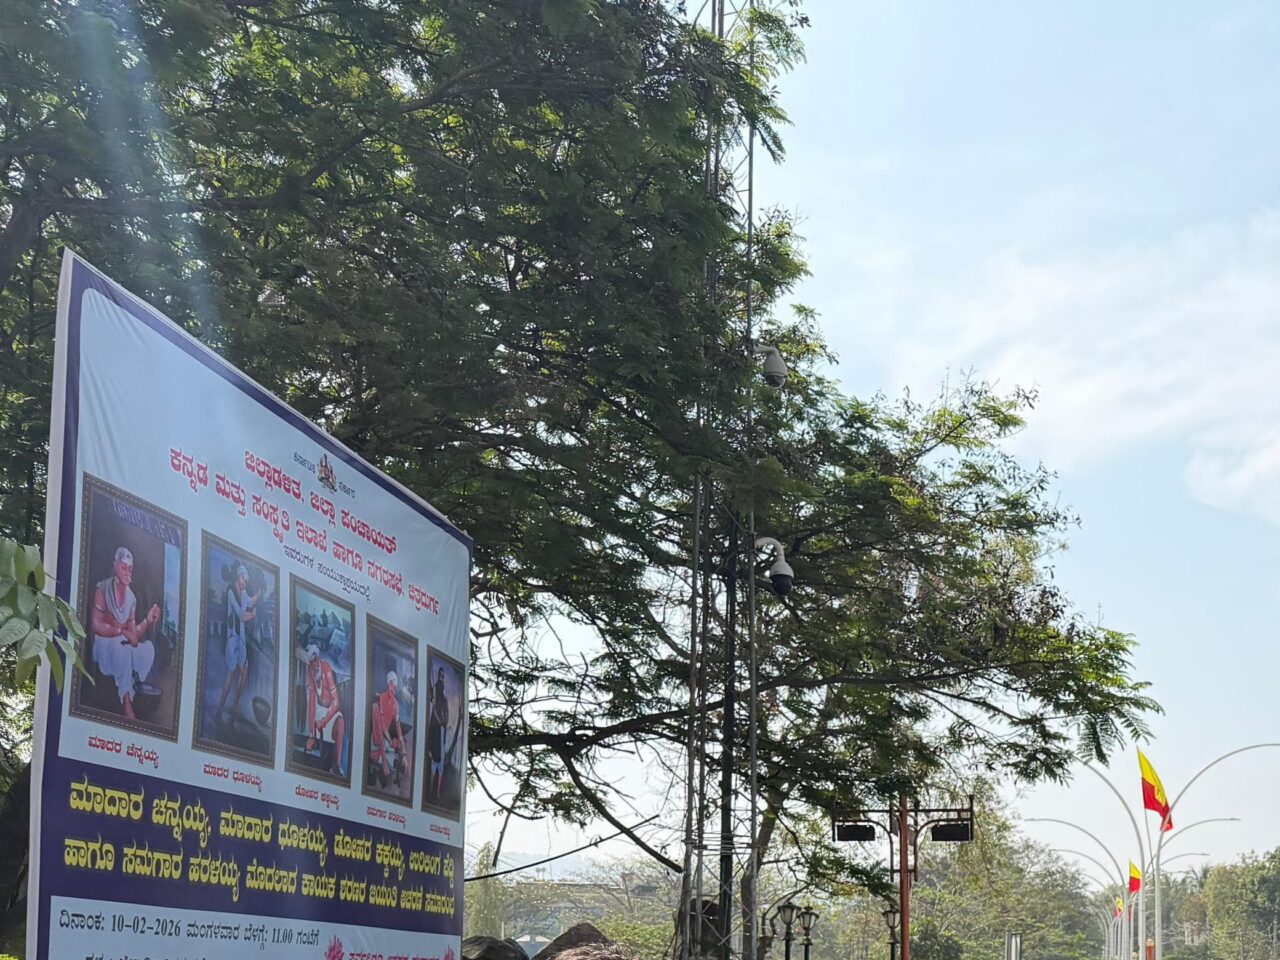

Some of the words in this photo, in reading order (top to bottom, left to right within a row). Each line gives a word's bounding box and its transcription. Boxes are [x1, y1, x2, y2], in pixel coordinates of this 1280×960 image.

[170, 449, 208, 493] ಕನ್ನಡ
[215, 473, 246, 516] ಮತ್ತು
[252, 494, 290, 545] ಸಂಸ್ಕೃತಿ
[296, 520, 327, 552] ಇಲಾಖೆ
[333, 541, 363, 572] ಹಾಗೂ
[310, 491, 336, 527] ಜಿಲ್ಲಾ
[88, 736, 121, 753] ಮಾದರ
[203, 763, 229, 779] ಮಾದರ
[70, 773, 144, 820] ಮಾದಾರ
[152, 791, 212, 848] ಚನ್ನಯ್ಯ,
[219, 804, 273, 843] ಮಾದಾರ
[334, 828, 373, 862] ಡೋಹರ
[64, 831, 115, 870] ಹಾಗೂ
[122, 840, 184, 880] ಸಮಗಾರ
[189, 850, 240, 902] ಹರಳಯ್ಯ
[246, 858, 298, 894] ಮೊದಲಾದ
[302, 868, 337, 899] ಕಾಯಕ
[339, 873, 367, 903] ಶರಣರ
[369, 880, 397, 907] ಜಯಂತಿ
[59, 909, 105, 931] ದಿನಾಂಕ:
[111, 914, 182, 937] 10-02-2026
[186, 919, 241, 941] ಮಂಗಳವಾರ
[272, 927, 292, 944] 11.00
[296, 929, 319, 946] ಗಂಟೆಗೆ
